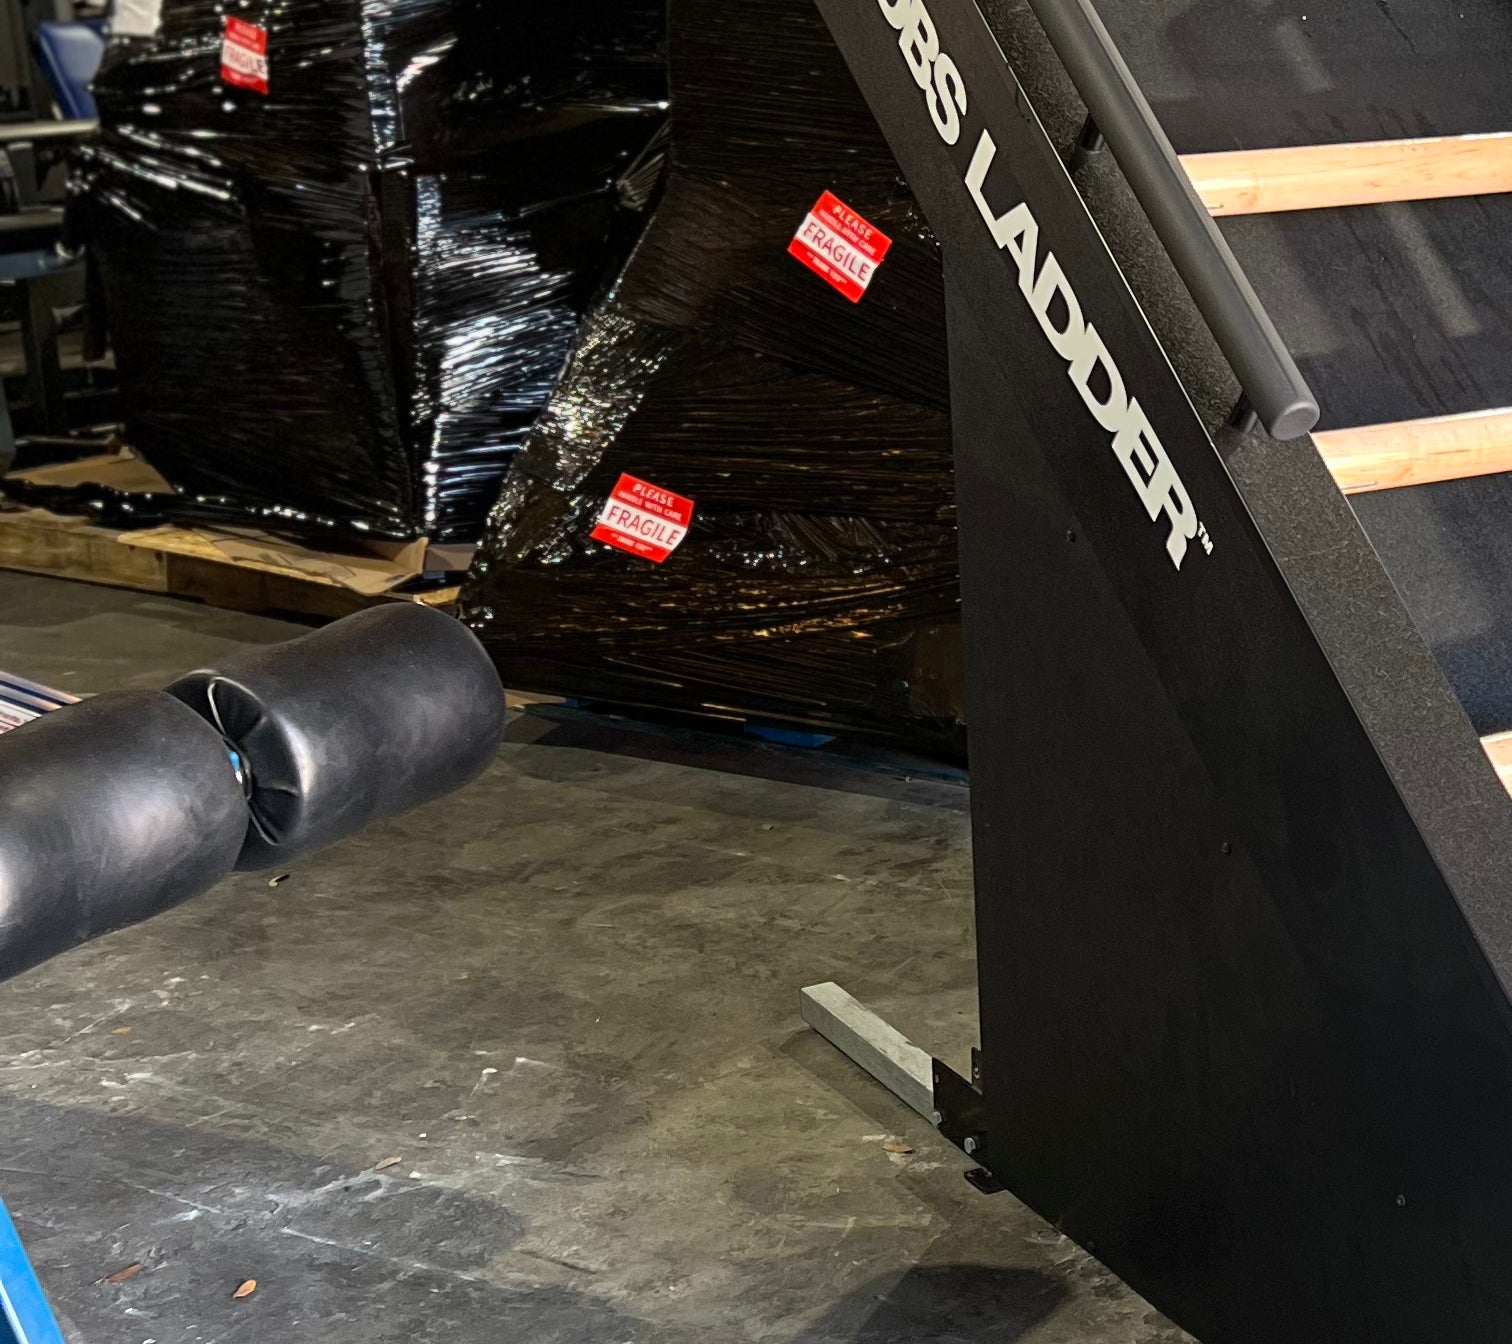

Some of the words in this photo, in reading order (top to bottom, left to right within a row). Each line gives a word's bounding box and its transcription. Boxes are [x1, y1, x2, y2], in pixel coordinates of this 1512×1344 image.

[832, 205, 873, 240] PLEASE
[803, 221, 871, 282] FRAGILE
[964, 129, 1198, 571] LADDER
[632, 484, 674, 507] PLEASE
[606, 505, 681, 546] FRAGILE
